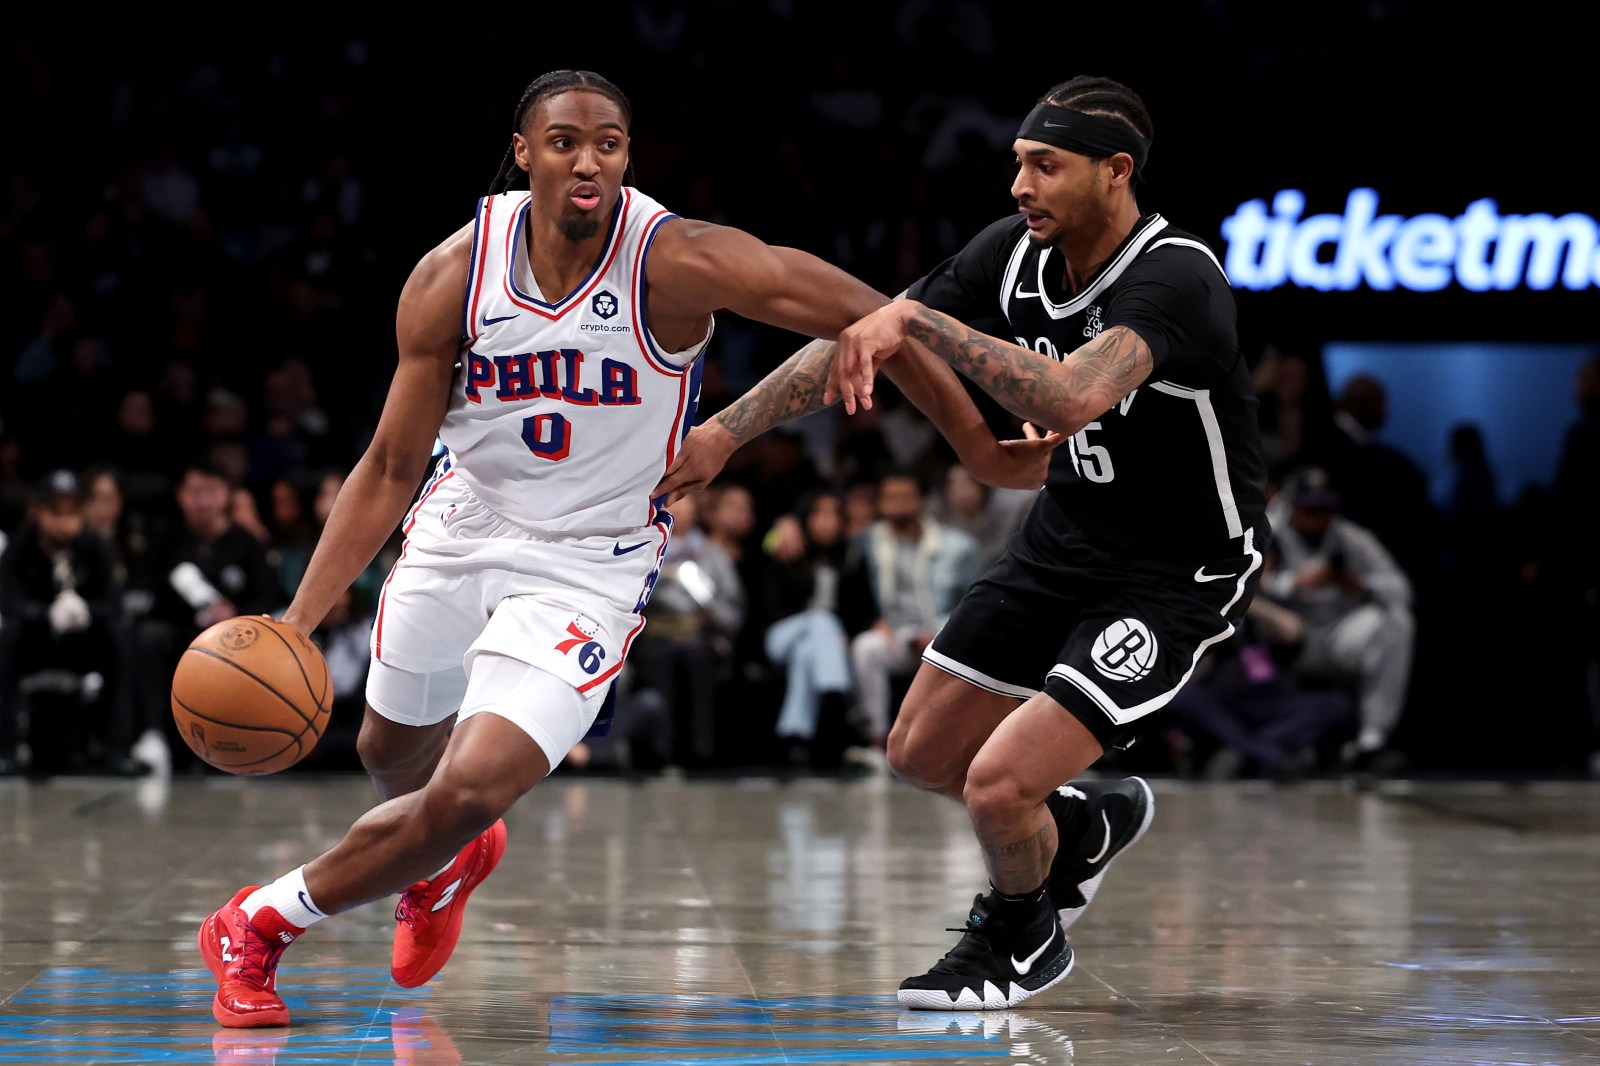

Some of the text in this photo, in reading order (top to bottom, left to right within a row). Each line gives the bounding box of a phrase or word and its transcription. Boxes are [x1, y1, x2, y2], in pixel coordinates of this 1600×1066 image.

[1220, 187, 1600, 292] ticketm
[580, 322, 631, 333] crypto.com
[464, 348, 642, 406] PHILA
[521, 411, 572, 461] 0
[553, 620, 606, 675] 76
